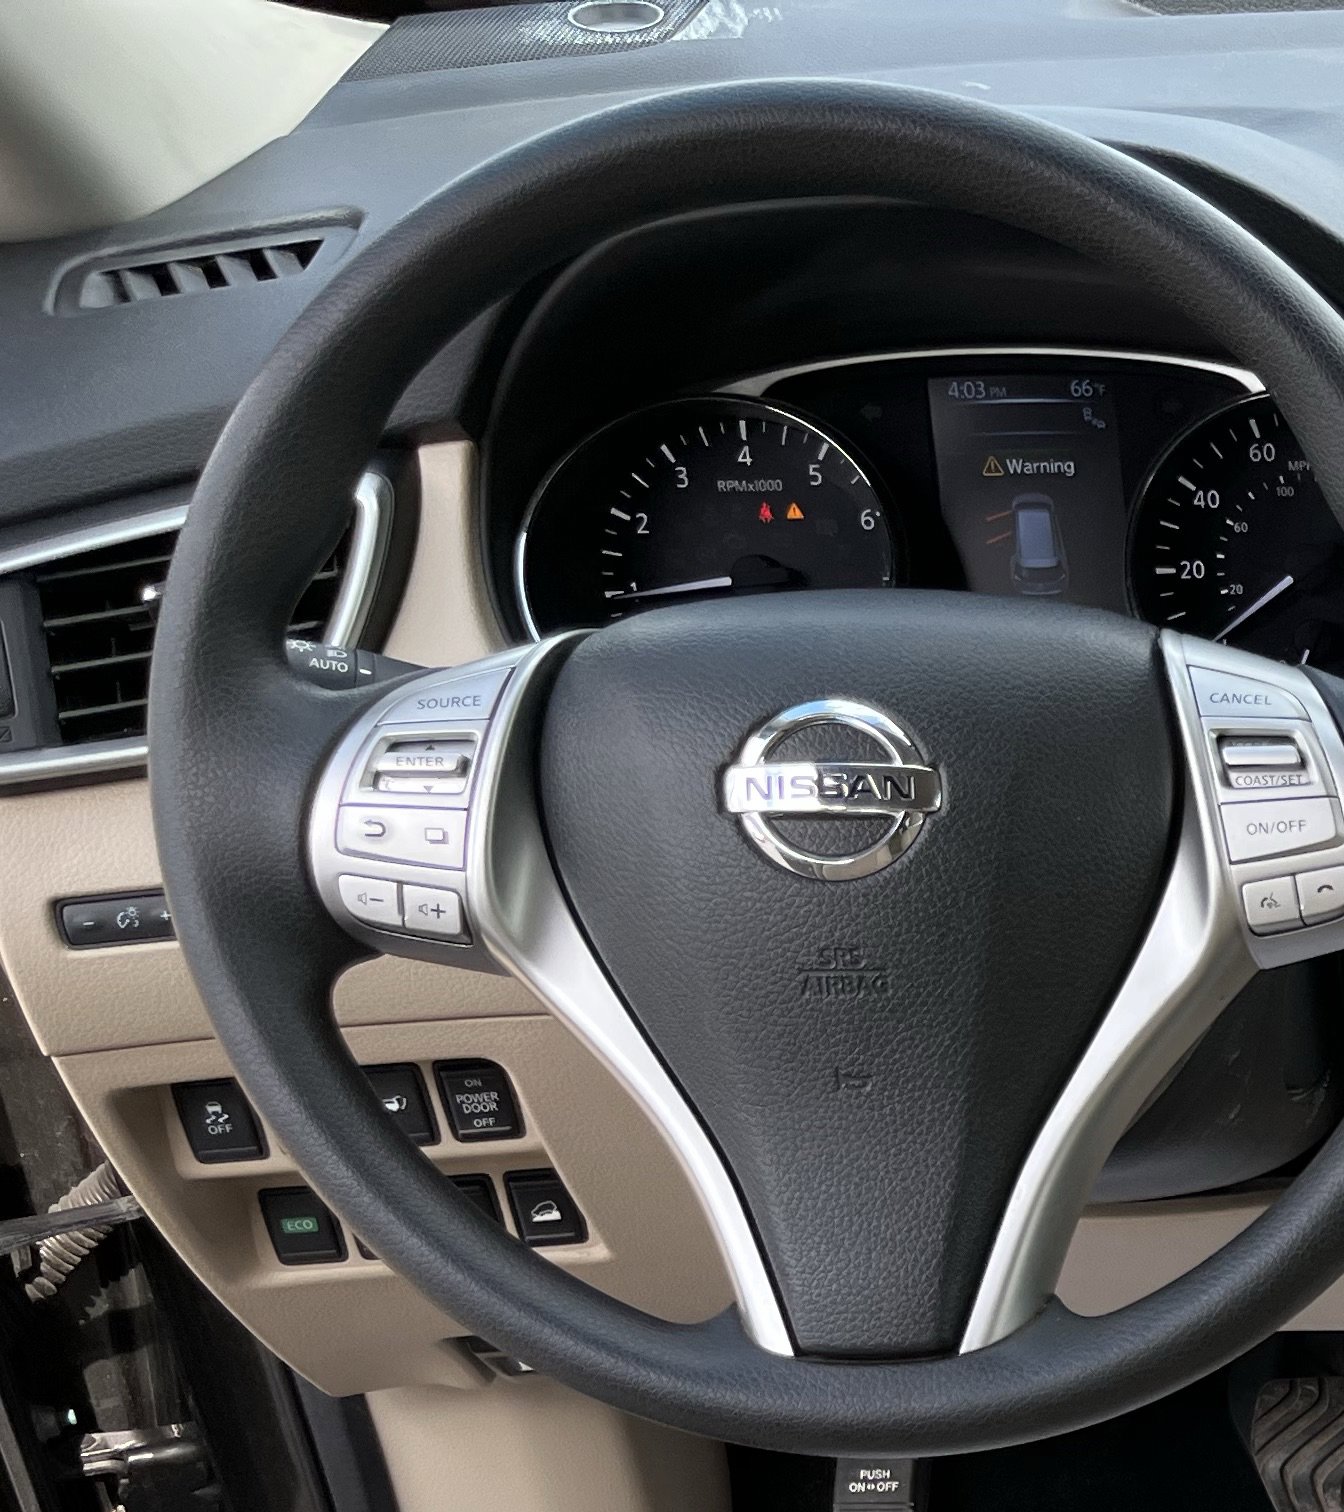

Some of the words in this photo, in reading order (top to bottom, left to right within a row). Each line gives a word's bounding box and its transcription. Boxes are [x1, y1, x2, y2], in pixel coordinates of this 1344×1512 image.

[948, 380, 987, 399] 4:03
[738, 446, 752, 466] 4
[1249, 443, 1276, 463] 60
[1006, 457, 1075, 477] Warning
[675, 467, 689, 488] 3
[808, 464, 822, 486] 5
[717, 479, 783, 493] RPMx1000
[1276, 486, 1295, 497] 100
[1193, 490, 1220, 509] 40
[635, 512, 650, 534] 2
[860, 508, 875, 531] 6
[1234, 521, 1249, 533] 60
[1180, 560, 1205, 579] 20
[1229, 584, 1244, 596] 20
[308, 657, 349, 673] AUTO
[416, 695, 481, 711] SOURCE
[1209, 692, 1273, 706] CANCEL
[395, 756, 444, 767] ENTER
[745, 773, 916, 802] NISSAN
[1235, 775, 1304, 787] COAST/SET
[1246, 819, 1307, 836] ON/OFF
[464, 1079, 482, 1087] ON
[456, 1091, 499, 1104] POWER
[462, 1101, 499, 1114] DOOR
[207, 1123, 233, 1135] OFF
[474, 1117, 496, 1127] OFF
[286, 1218, 314, 1231] ECO
[860, 1469, 891, 1480] PUSH
